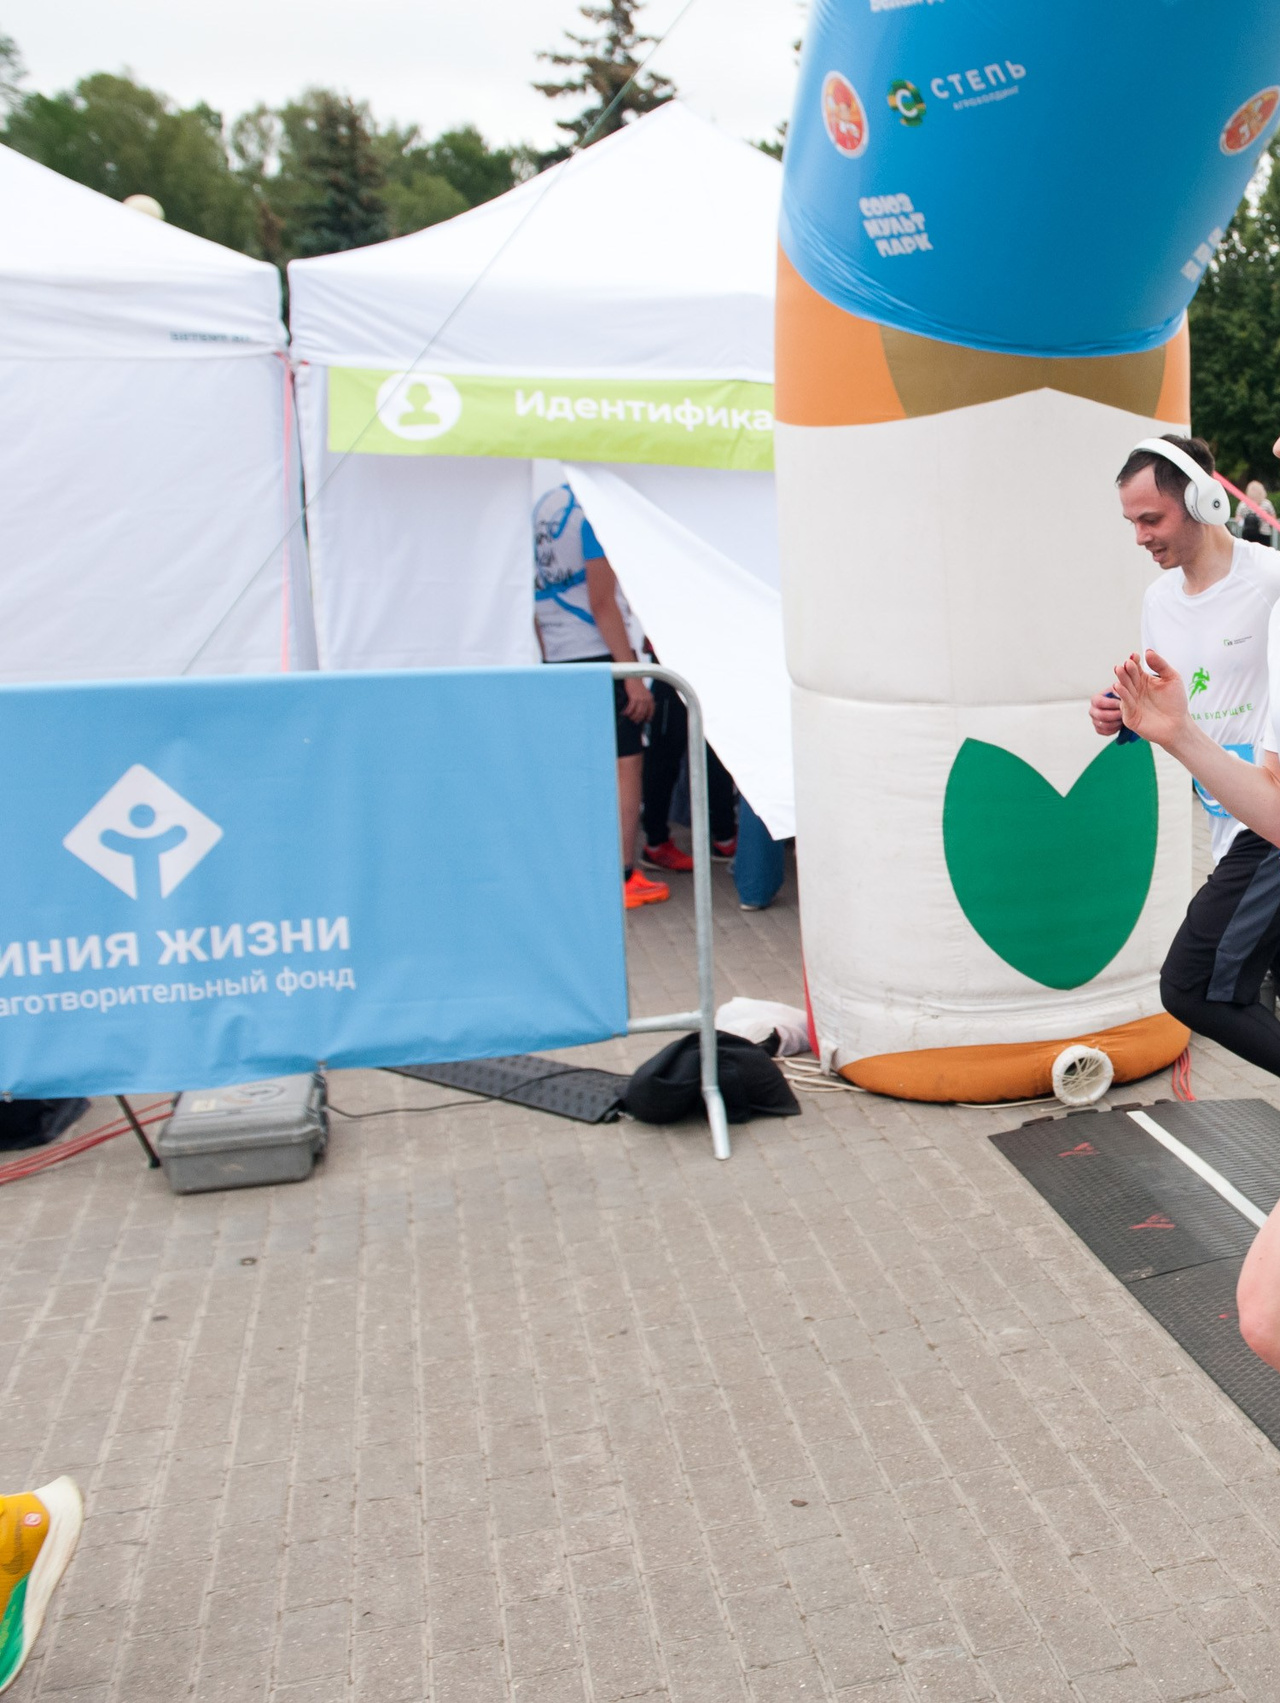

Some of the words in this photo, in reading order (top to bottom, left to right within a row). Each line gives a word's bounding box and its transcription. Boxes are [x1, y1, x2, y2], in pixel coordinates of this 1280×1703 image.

[930, 60, 1026, 99] СТЕПЬ
[859, 193, 914, 217] СОЮЗ
[875, 233, 934, 258] ПАРК
[514, 388, 773, 432] Идентифика
[1205, 703, 1253, 720] БУДУЩЕЕ
[156, 916, 350, 965] ЖИЗНИ
[276, 966, 356, 996] фонд
